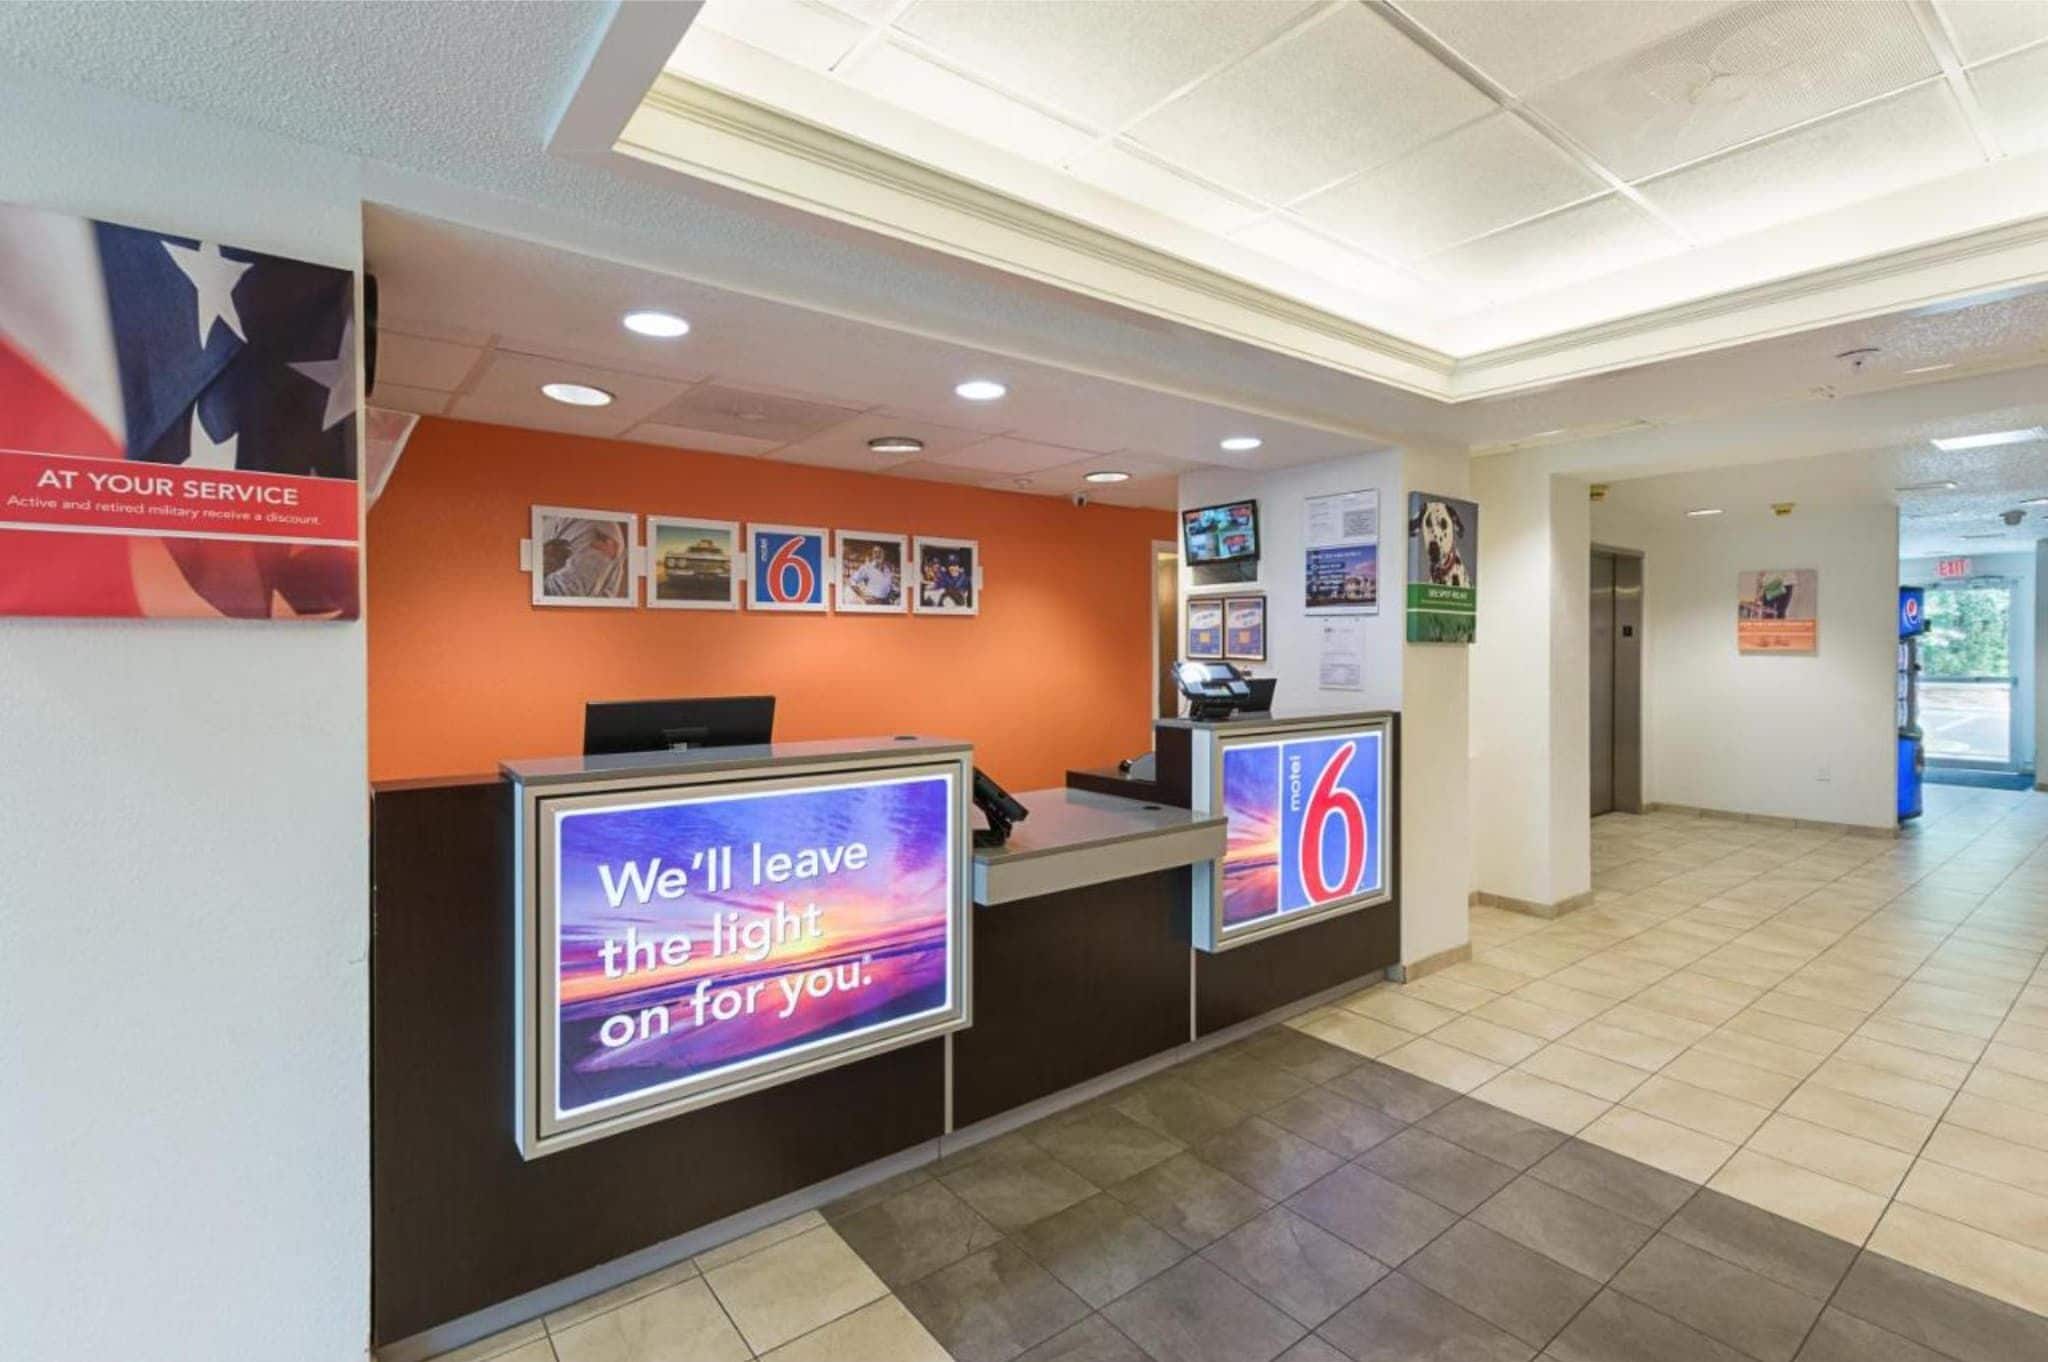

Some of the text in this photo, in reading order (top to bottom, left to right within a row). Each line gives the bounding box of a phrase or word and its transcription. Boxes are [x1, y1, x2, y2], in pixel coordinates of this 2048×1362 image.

[7, 494, 321, 526] Active and retired military receive a discount.
[37, 469, 299, 506] AT YOUR SERVICE
[767, 536, 814, 603] 6
[1938, 559, 1968, 577] EXIT
[1290, 754, 1301, 812] motel
[1300, 741, 1367, 905] 6
[597, 841, 870, 908] We'll leave
[597, 901, 825, 980] the light
[599, 1003, 671, 1049] on
[691, 979, 767, 1028] for
